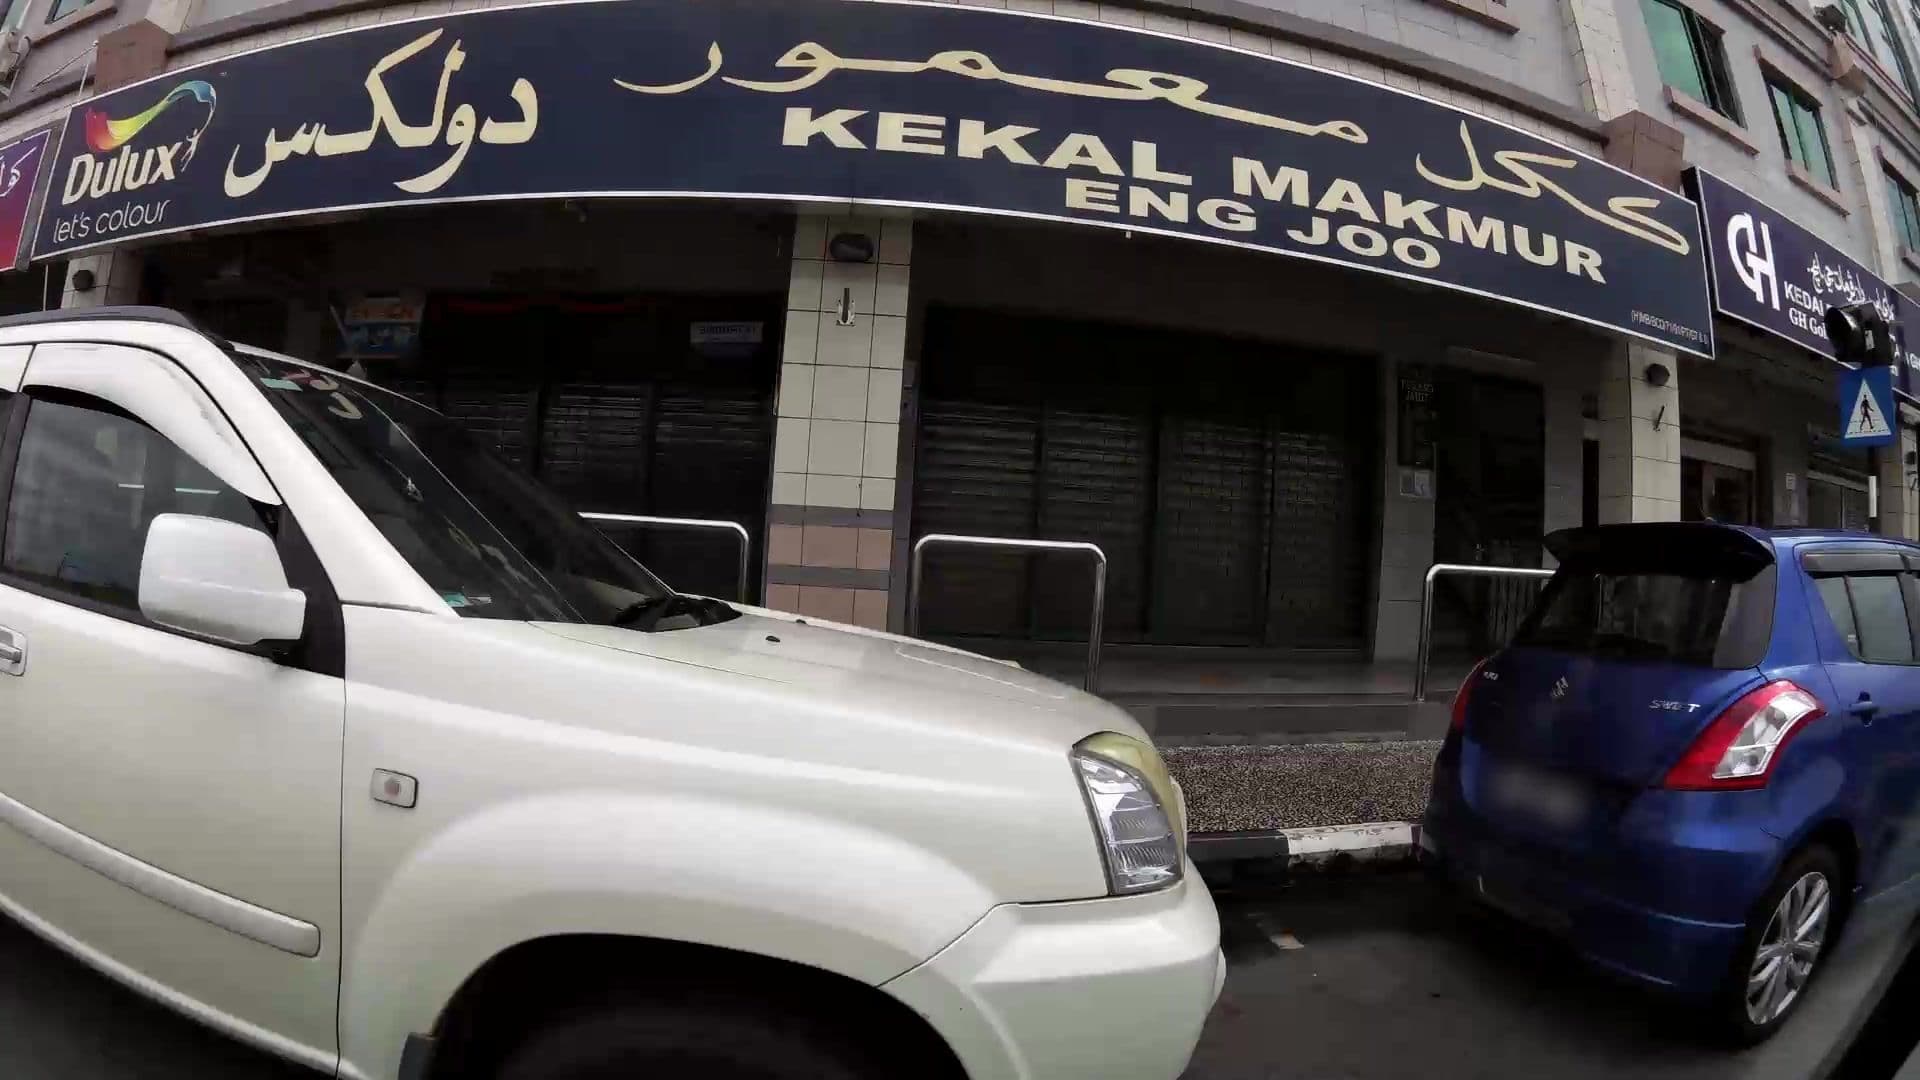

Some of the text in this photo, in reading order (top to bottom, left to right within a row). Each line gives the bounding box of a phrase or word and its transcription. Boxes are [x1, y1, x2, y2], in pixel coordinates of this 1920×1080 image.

[62, 141, 182, 205] Dulux
[782, 107, 1607, 284] KEKAL MAKMUR
[53, 200, 171, 244] let's colour
[1066, 178, 1441, 268] ENG JOO
[1783, 280, 1824, 317] KEDAI
[1788, 307, 1809, 331] GH
